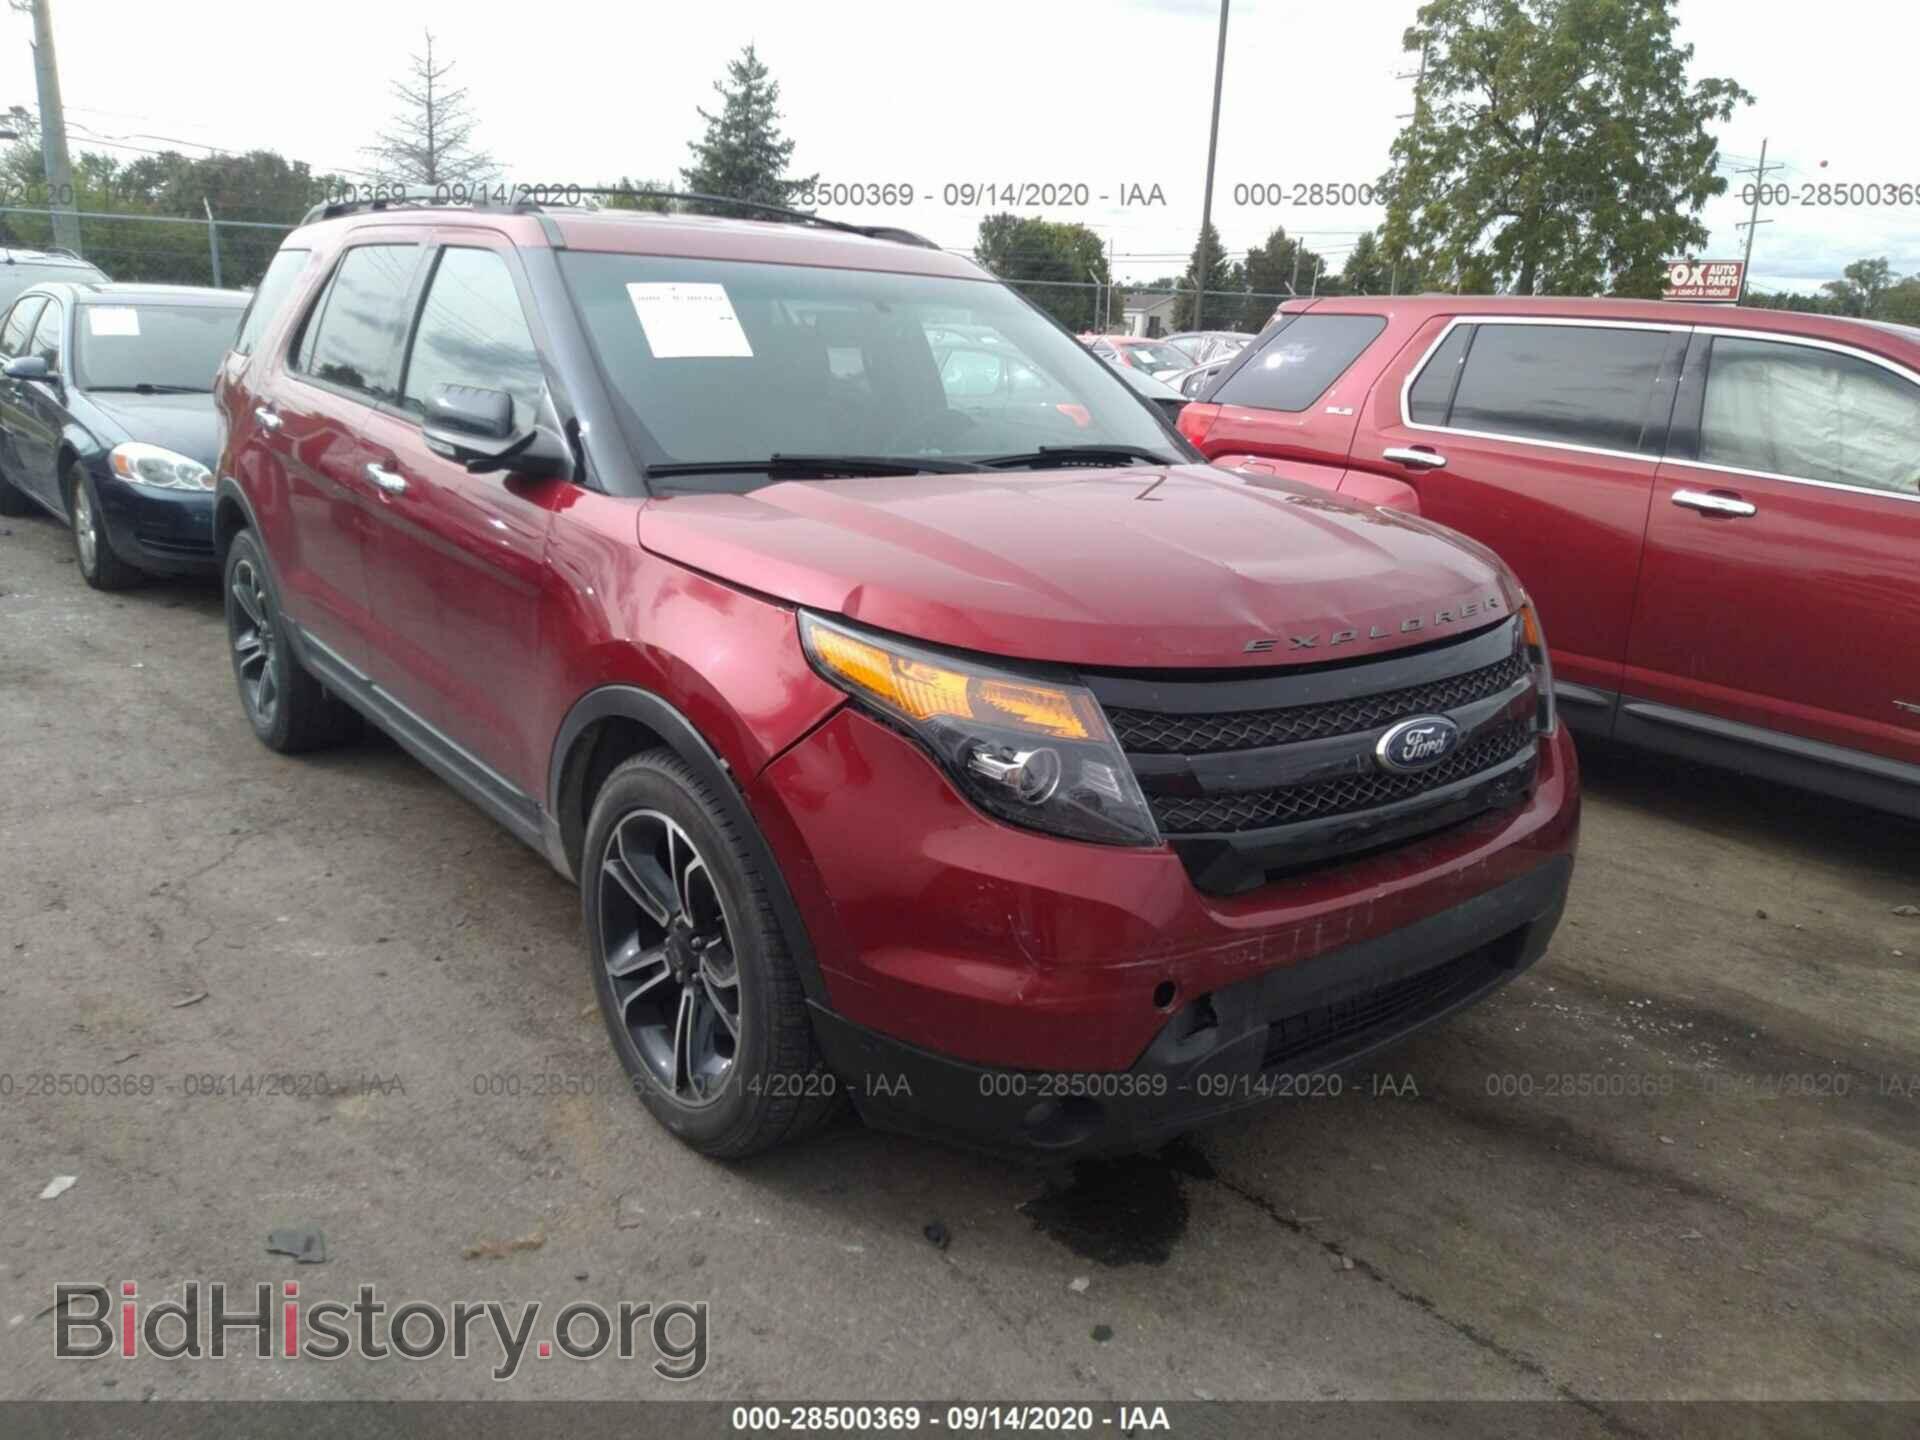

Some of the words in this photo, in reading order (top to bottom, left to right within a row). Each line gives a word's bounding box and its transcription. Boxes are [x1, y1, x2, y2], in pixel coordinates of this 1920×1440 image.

[1708, 264, 1737, 275] AUTO
[1707, 276, 1738, 287] PARTS
[1243, 597, 1499, 653] EXPLORER
[1403, 727, 1448, 760] Ford
